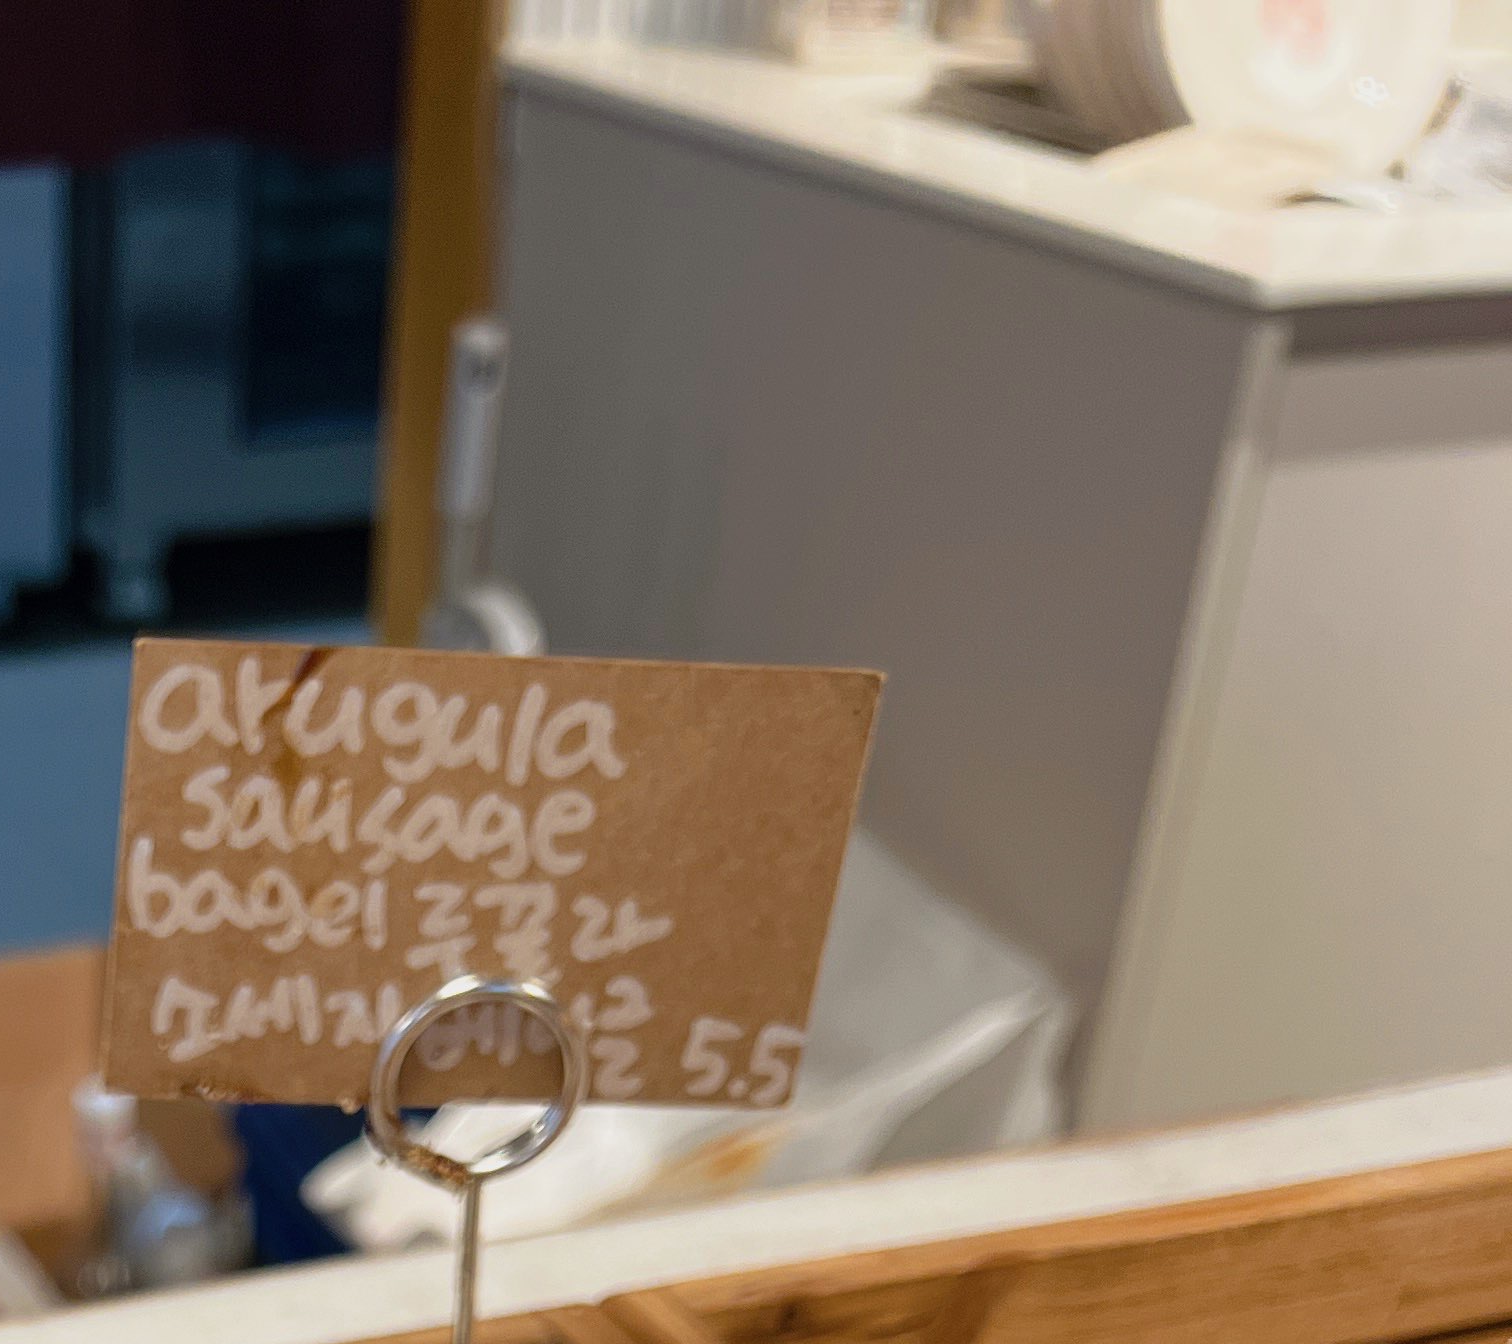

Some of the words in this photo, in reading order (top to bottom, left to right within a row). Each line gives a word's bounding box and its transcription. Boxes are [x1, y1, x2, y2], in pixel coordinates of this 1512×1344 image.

[138, 657, 627, 786] arugula
[181, 766, 596, 878] sausage
[130, 836, 386, 953] bagel
[681, 1017, 807, 1105] 5.5
